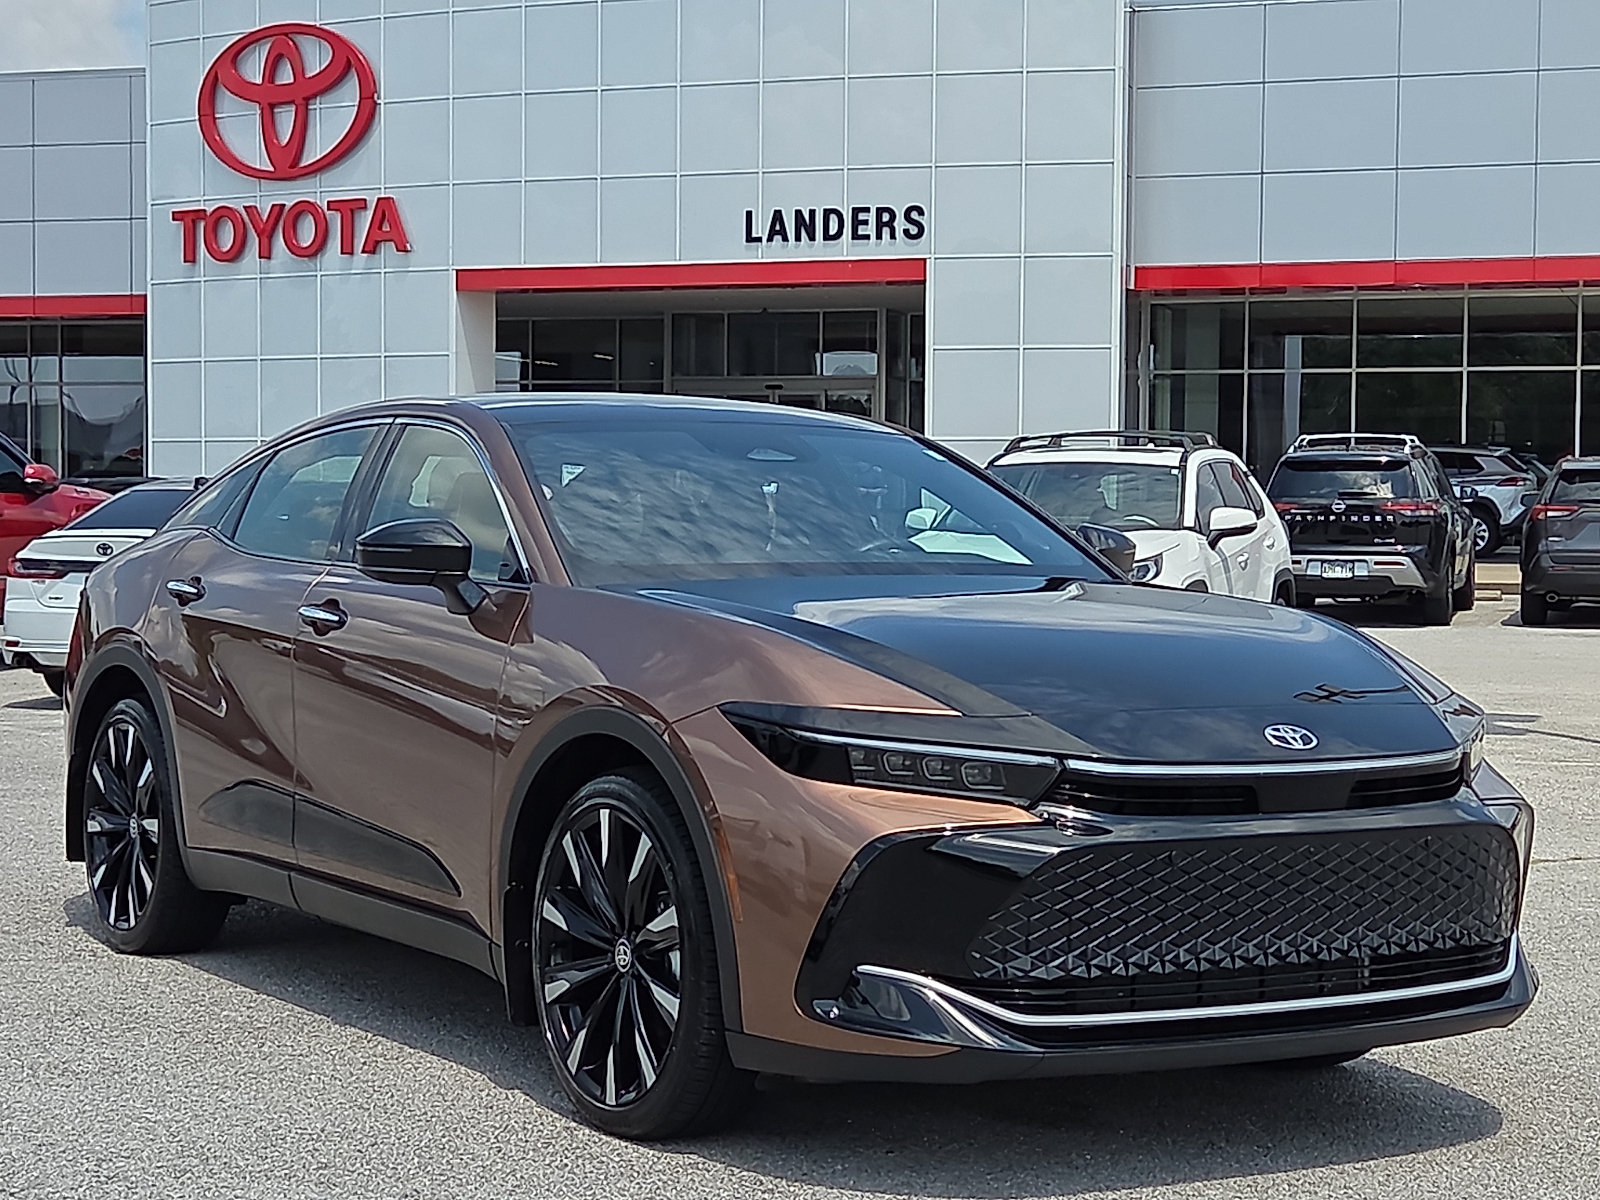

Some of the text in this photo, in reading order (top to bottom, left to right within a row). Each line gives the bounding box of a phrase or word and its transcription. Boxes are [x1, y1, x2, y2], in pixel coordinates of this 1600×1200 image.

[172, 196, 412, 264] TOYOTA
[744, 204, 927, 243] LANDERS
[1284, 514, 1394, 523] PATHFINDER
